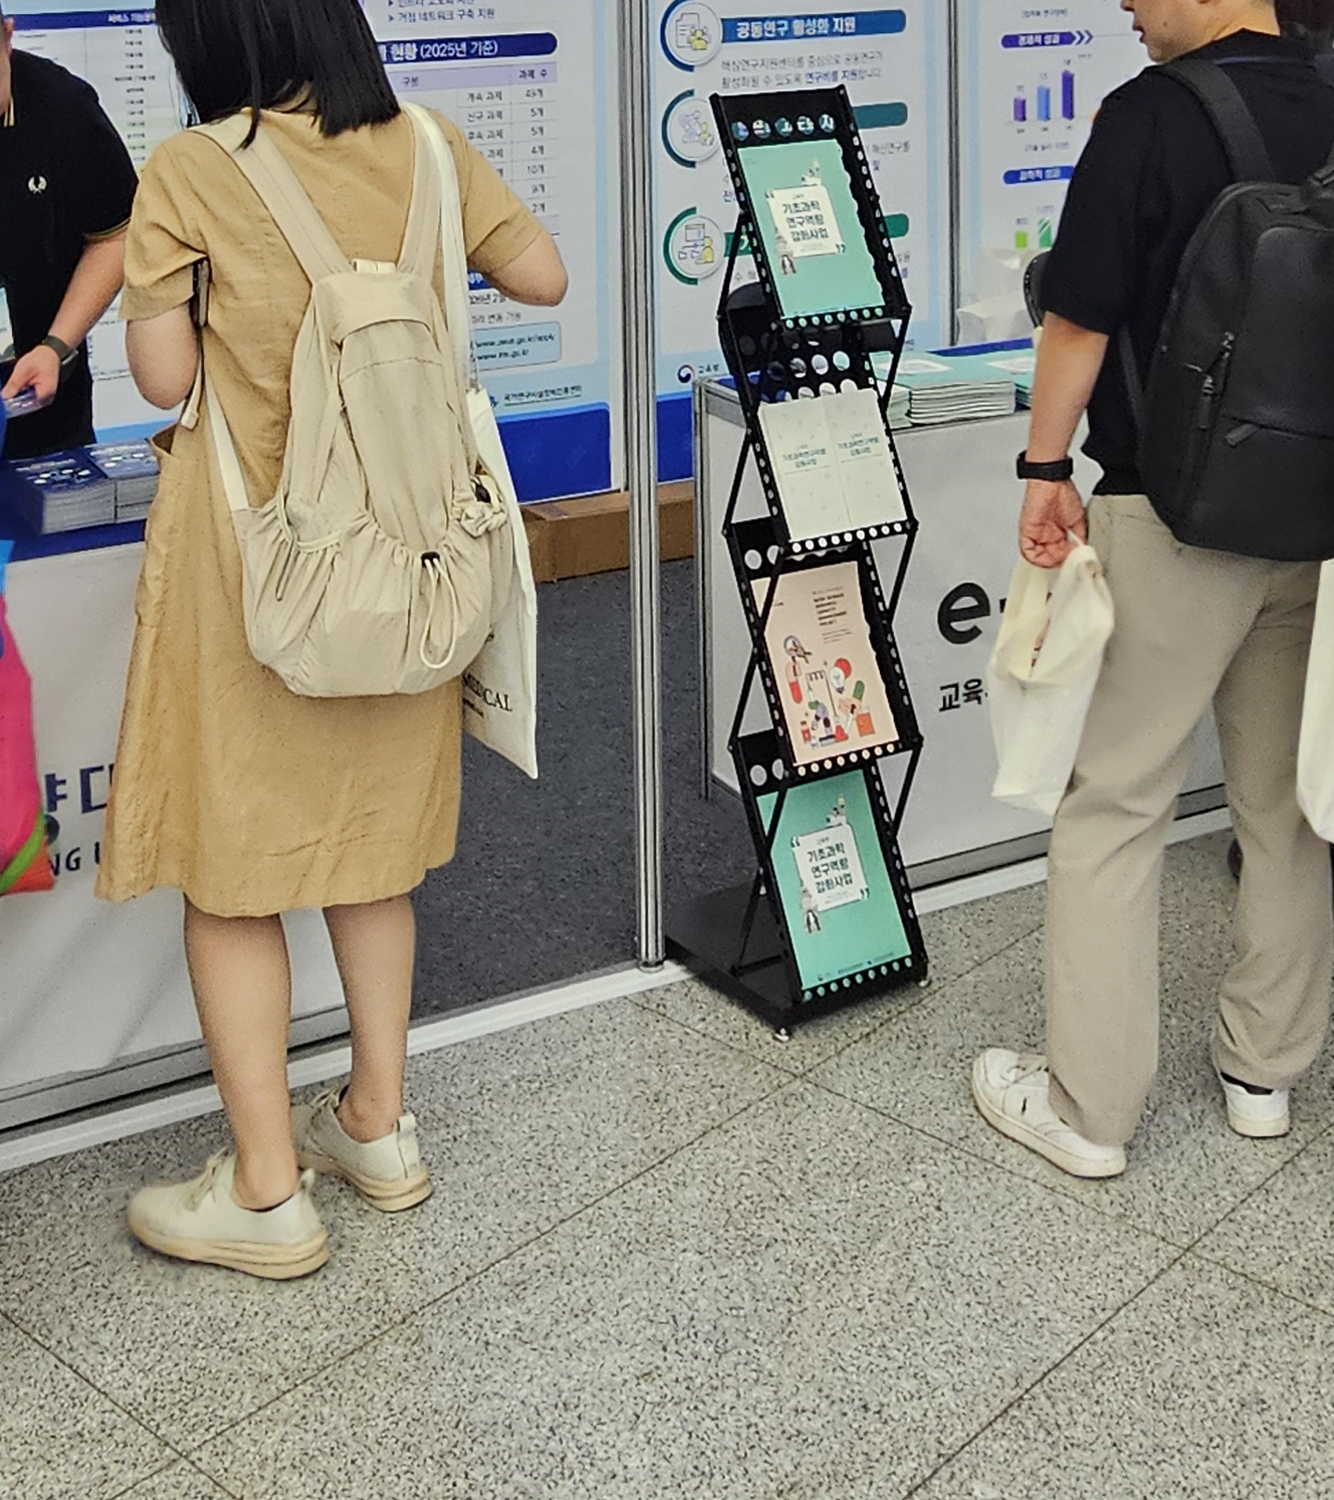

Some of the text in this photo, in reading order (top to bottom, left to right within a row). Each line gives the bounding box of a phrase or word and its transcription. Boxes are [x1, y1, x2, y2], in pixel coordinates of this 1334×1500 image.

[736, 20, 789, 39] 공동연구
[832, 16, 856, 33] 지원
[420, 41, 467, 58] (2025년
[469, 40, 499, 56] 기준)
[938, 679, 988, 712] 교육
